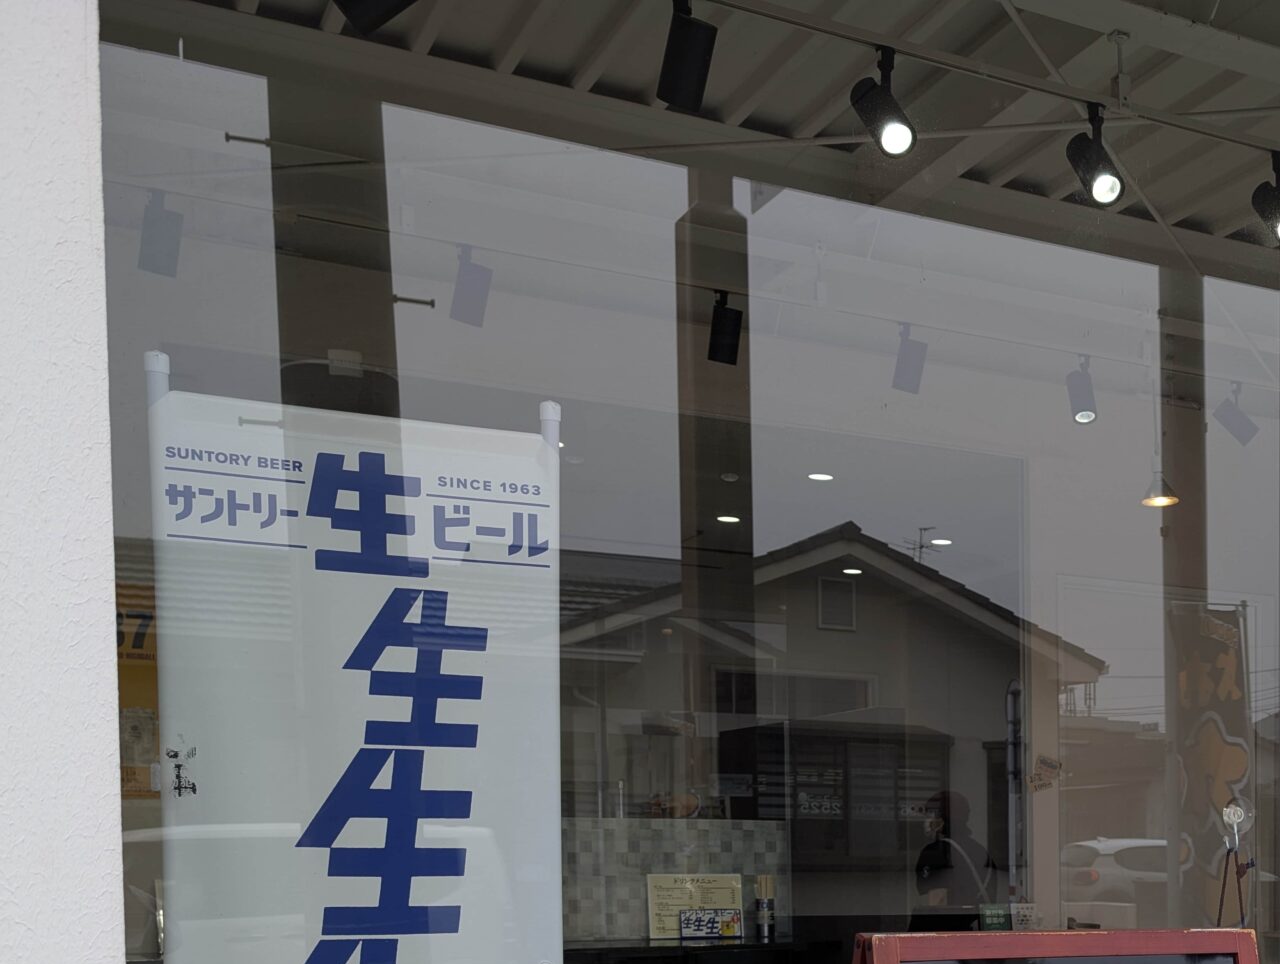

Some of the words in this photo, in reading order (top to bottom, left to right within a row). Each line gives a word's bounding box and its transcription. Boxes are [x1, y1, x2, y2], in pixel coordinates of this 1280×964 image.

[165, 446, 252, 467] SUNTORY
[257, 456, 303, 472] BEER
[438, 476, 492, 491] SINCE
[499, 482, 542, 496] 1963
[165, 484, 299, 529] サントリー
[433, 504, 549, 557] ビール
